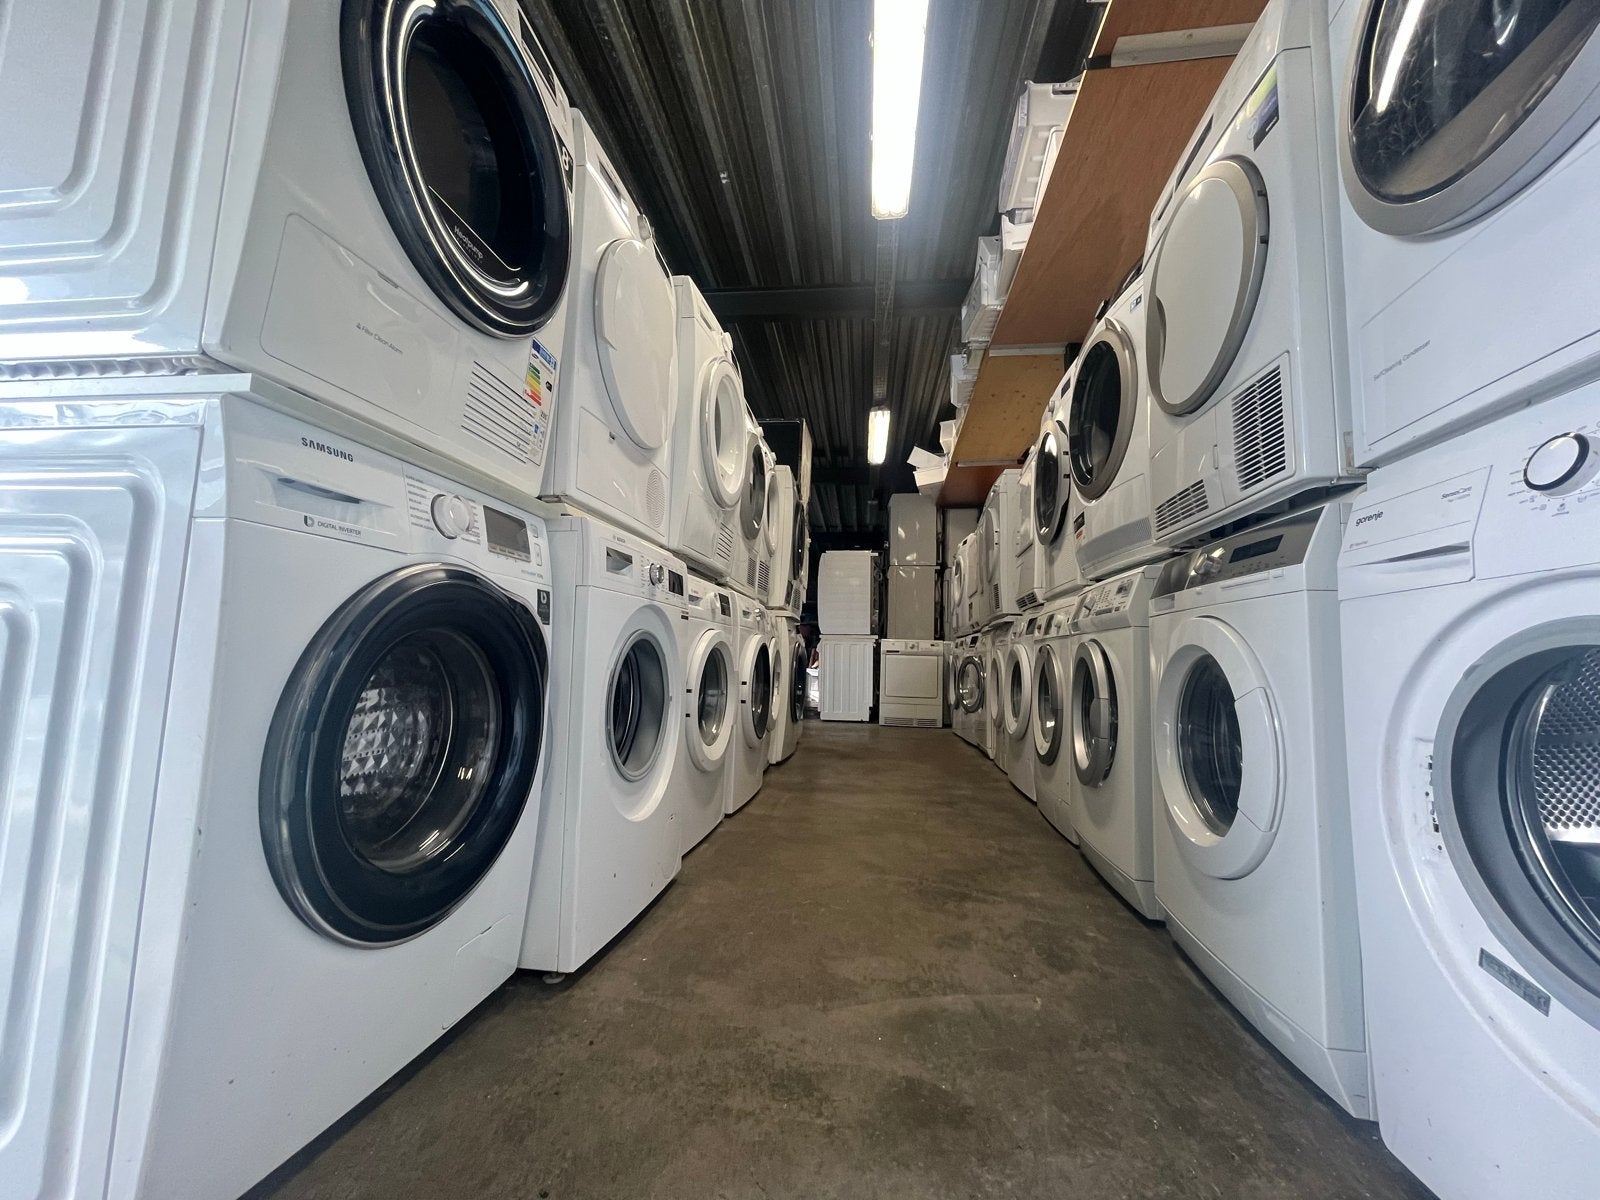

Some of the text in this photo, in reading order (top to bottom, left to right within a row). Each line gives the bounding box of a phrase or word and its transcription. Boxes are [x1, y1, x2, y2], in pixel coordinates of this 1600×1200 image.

[301, 437, 354, 462] SAMSUNG
[1355, 510, 1384, 527] gorenje
[317, 520, 338, 531] DIGITAL
[338, 525, 362, 536] INVERTER
